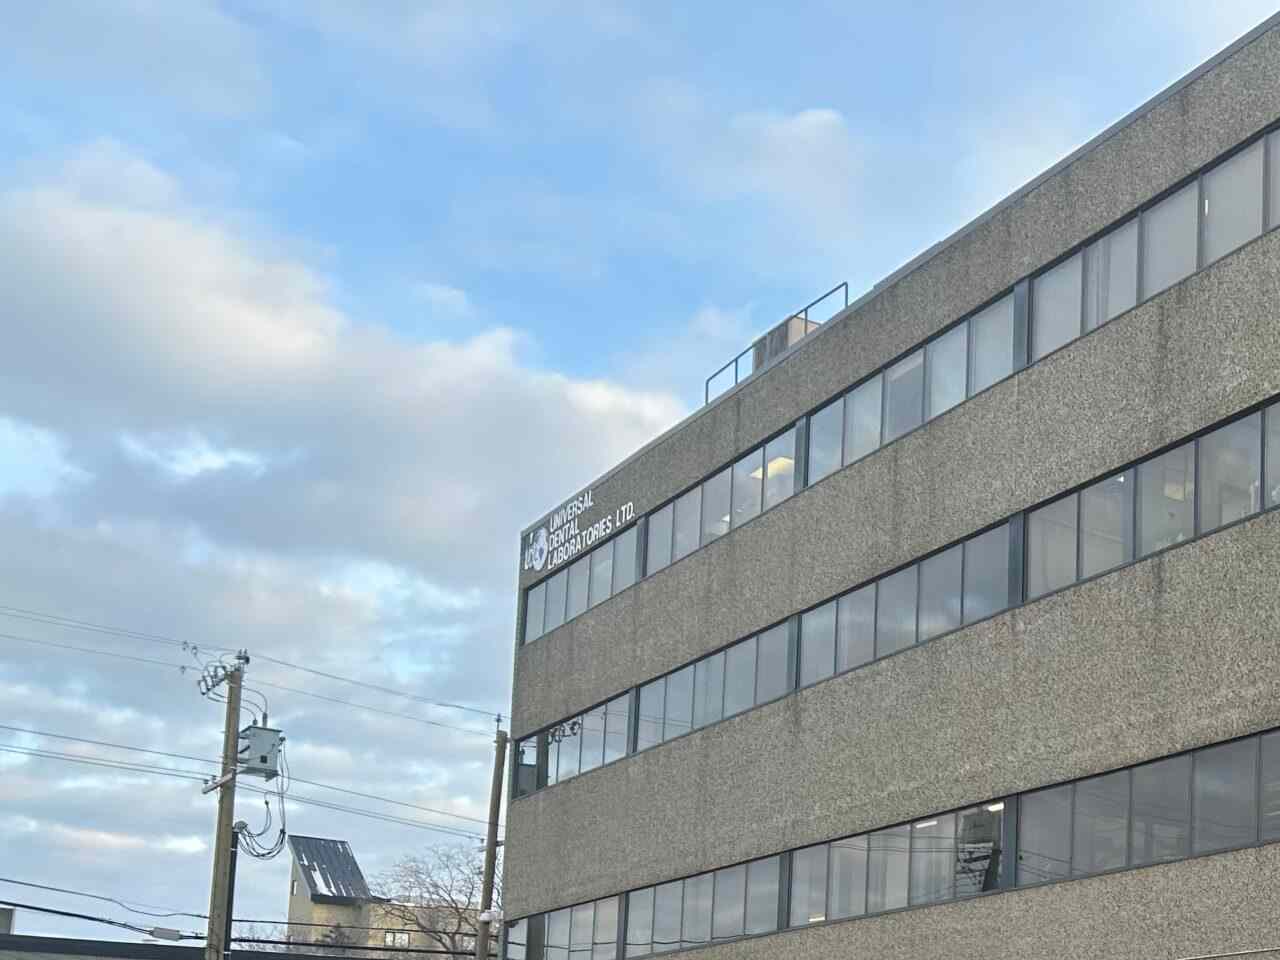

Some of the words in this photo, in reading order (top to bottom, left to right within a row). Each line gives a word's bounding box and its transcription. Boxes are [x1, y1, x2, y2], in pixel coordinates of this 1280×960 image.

[550, 490, 594, 532] UNIVERSAL
[547, 516, 612, 569] LABORATORIES
[616, 502, 635, 527] LTD.
[549, 520, 580, 550] DENTAL
